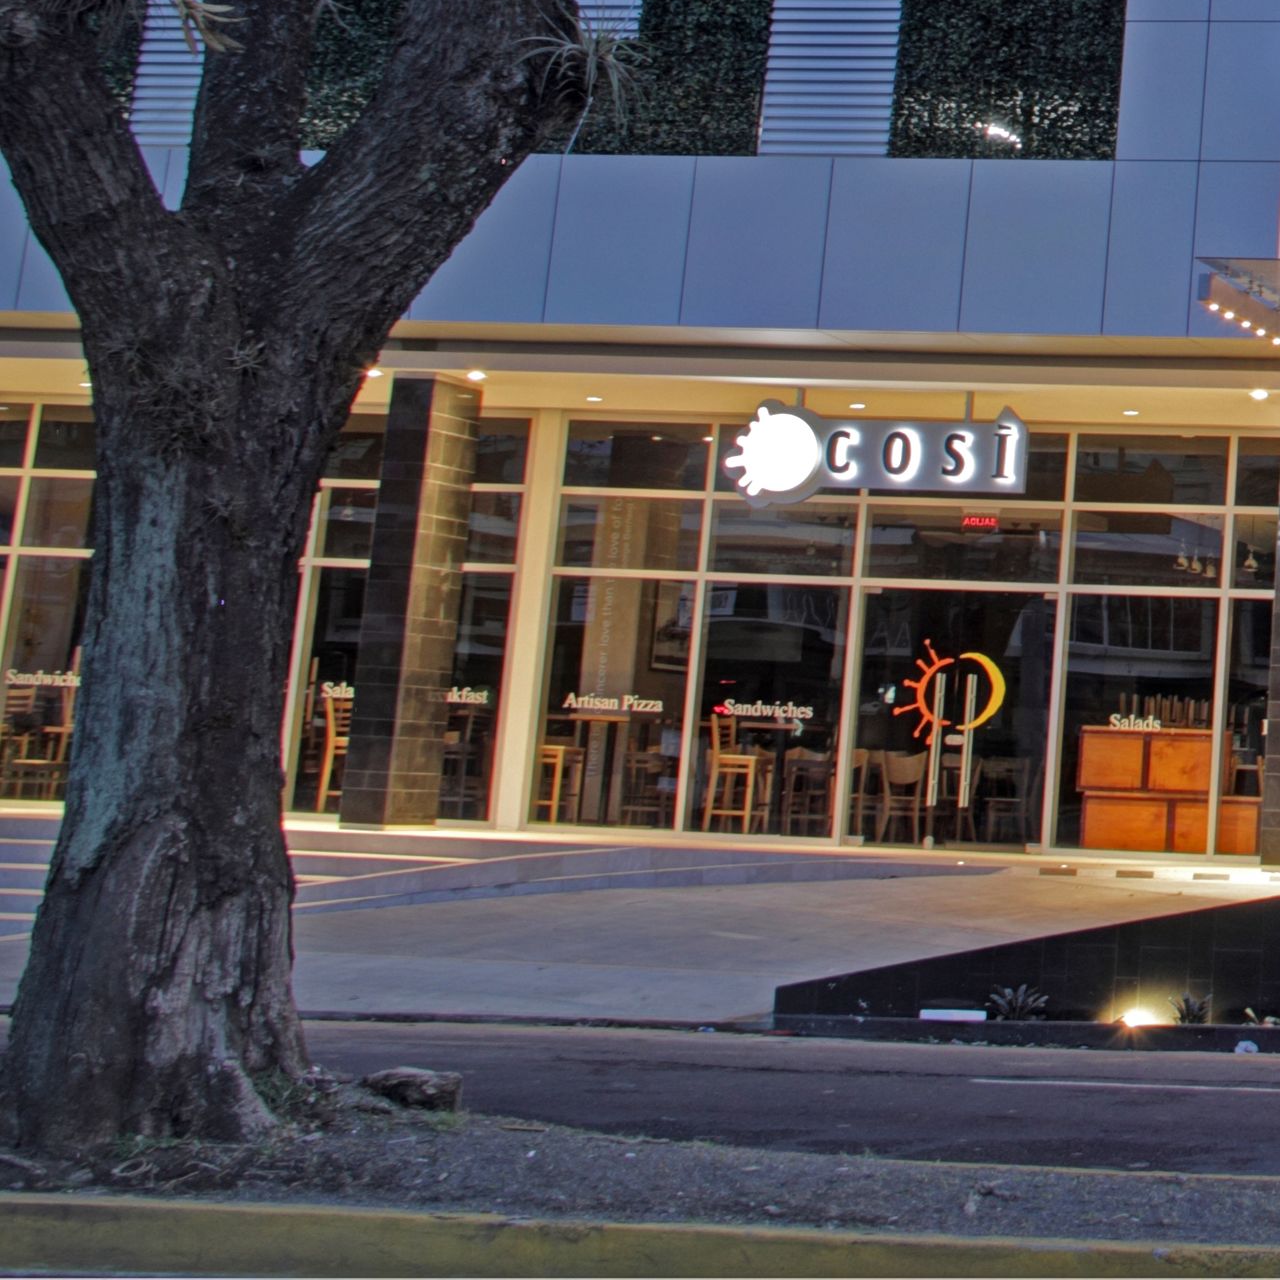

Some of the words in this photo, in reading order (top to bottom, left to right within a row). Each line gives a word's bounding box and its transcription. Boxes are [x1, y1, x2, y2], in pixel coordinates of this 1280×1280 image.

[562, 692, 618, 710] Artisan
[621, 694, 663, 712] Pizza
[723, 699, 814, 719] Sandwiches
[1109, 713, 1161, 732] Salads
